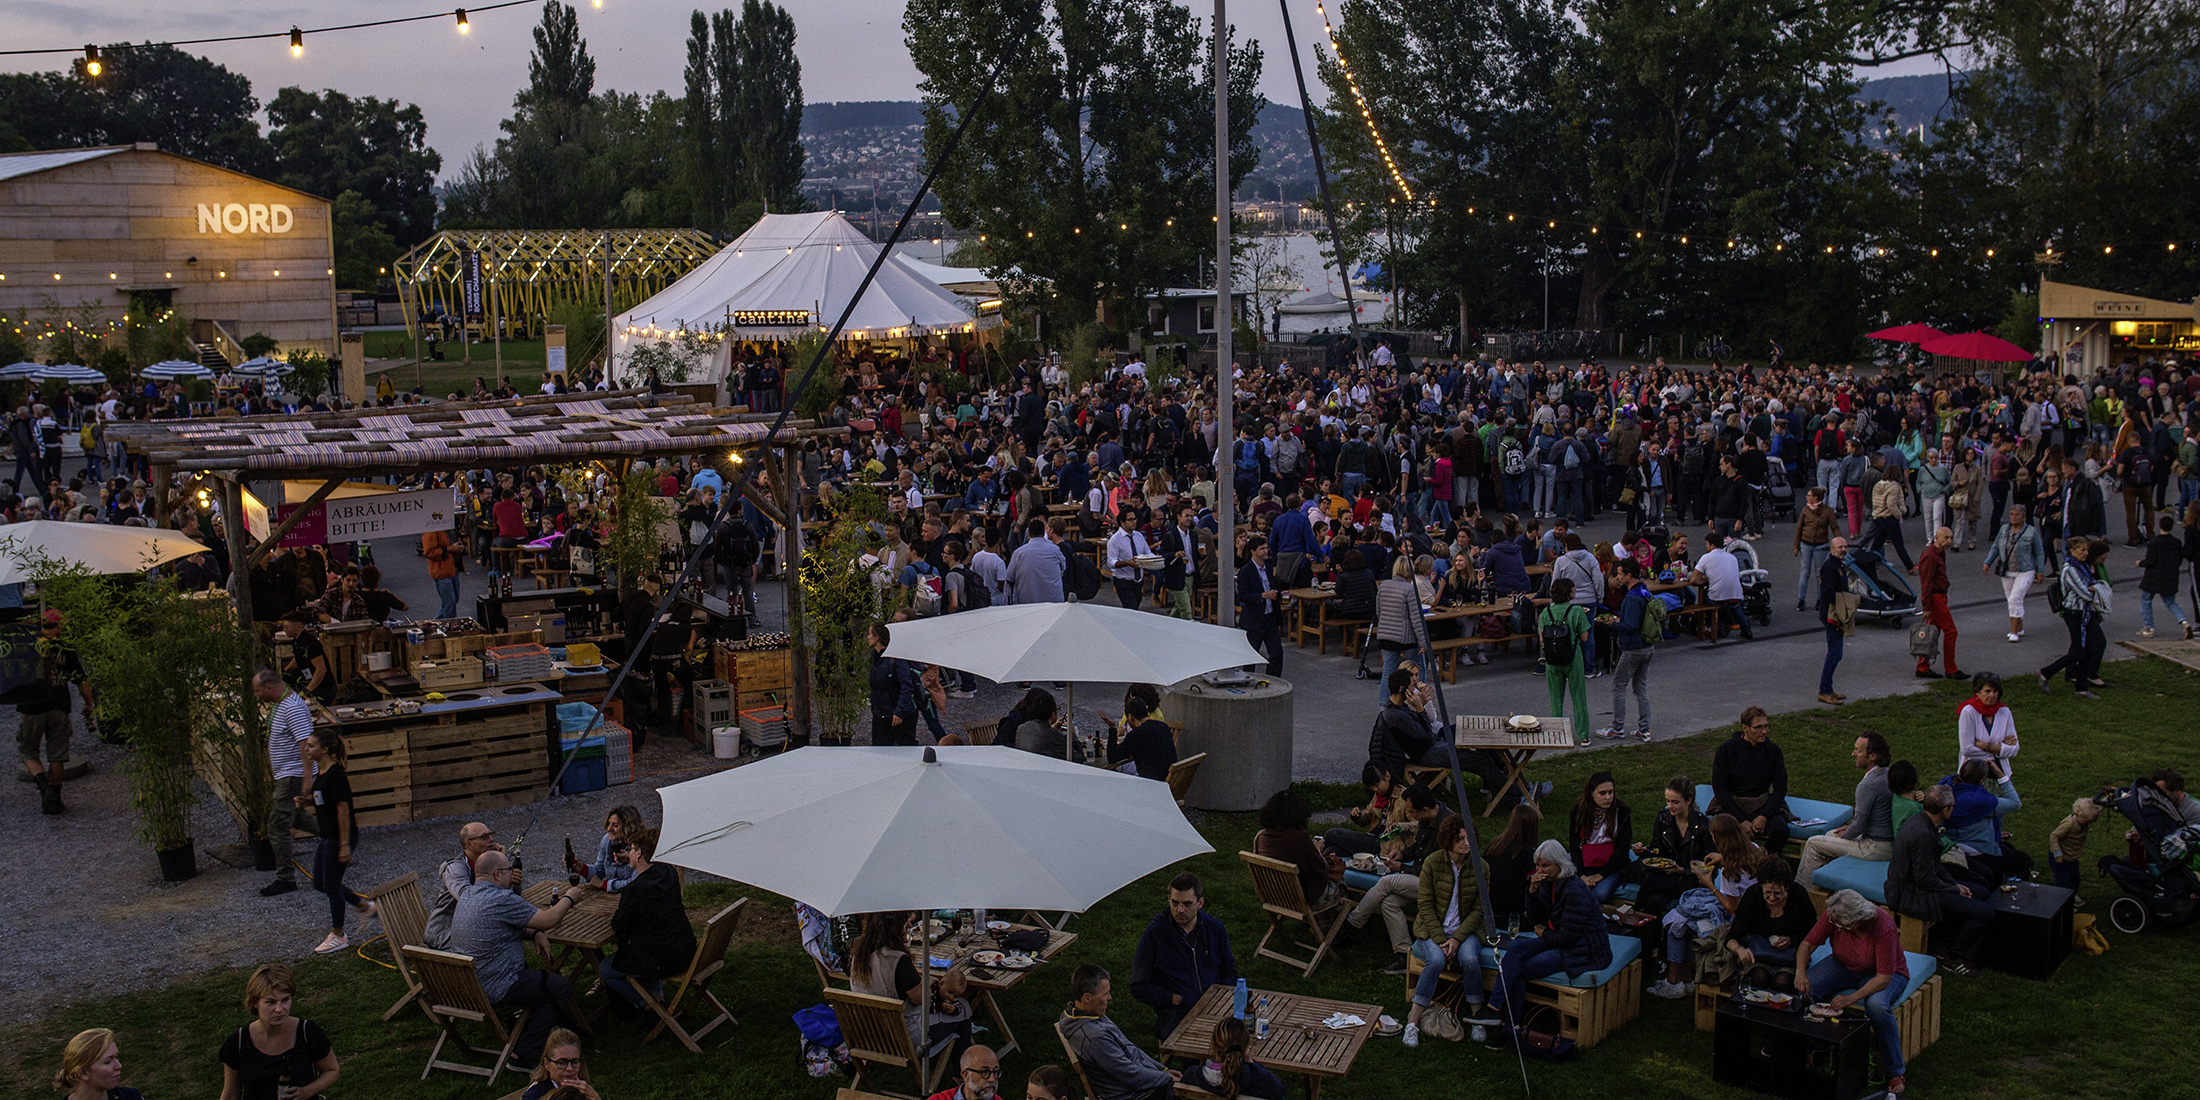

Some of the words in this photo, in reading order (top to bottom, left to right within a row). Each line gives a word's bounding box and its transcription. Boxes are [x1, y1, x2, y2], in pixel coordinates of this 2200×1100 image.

[197, 203, 294, 234] NORD
[738, 313, 805, 325] cantina
[331, 499, 424, 520] ABRÄUMEN
[332, 520, 385, 536] BITTE!
